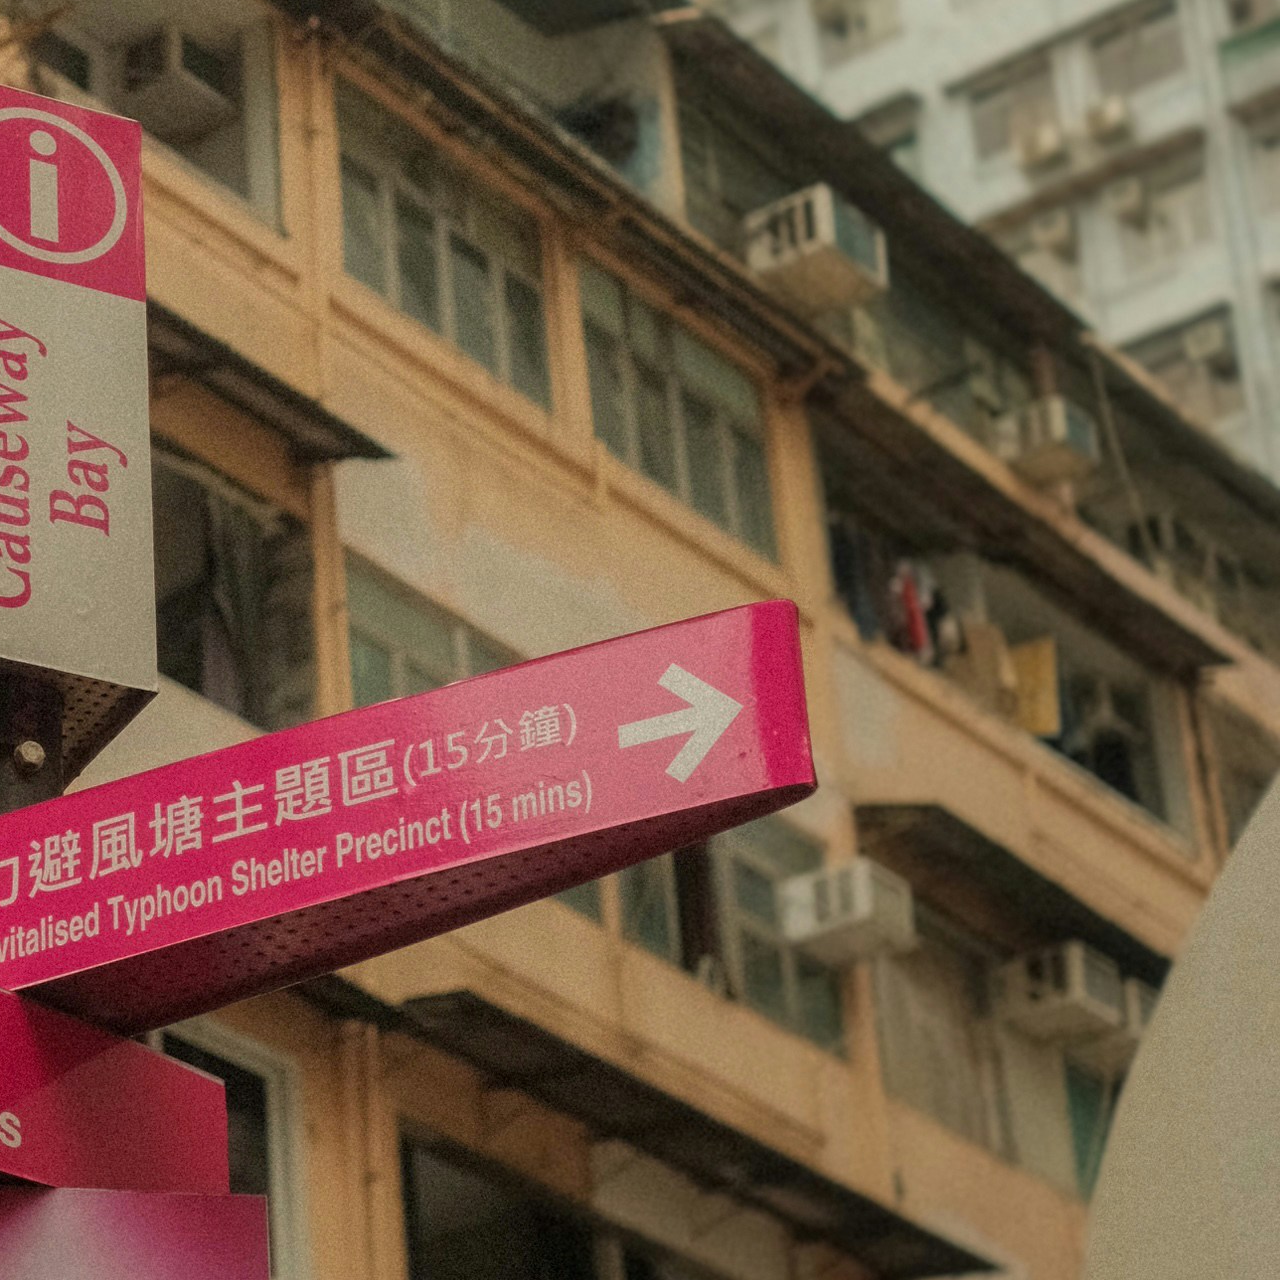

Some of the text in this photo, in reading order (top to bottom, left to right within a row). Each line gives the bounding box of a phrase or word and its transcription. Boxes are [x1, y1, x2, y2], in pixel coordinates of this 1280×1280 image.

[49, 420, 128, 537] Bay
[106, 874, 222, 936] Typhoon
[231, 846, 328, 897] Shelter
[336, 807, 451, 869] Precinct
[459, 793, 503, 845] (15
[512, 769, 593, 822] mins)
